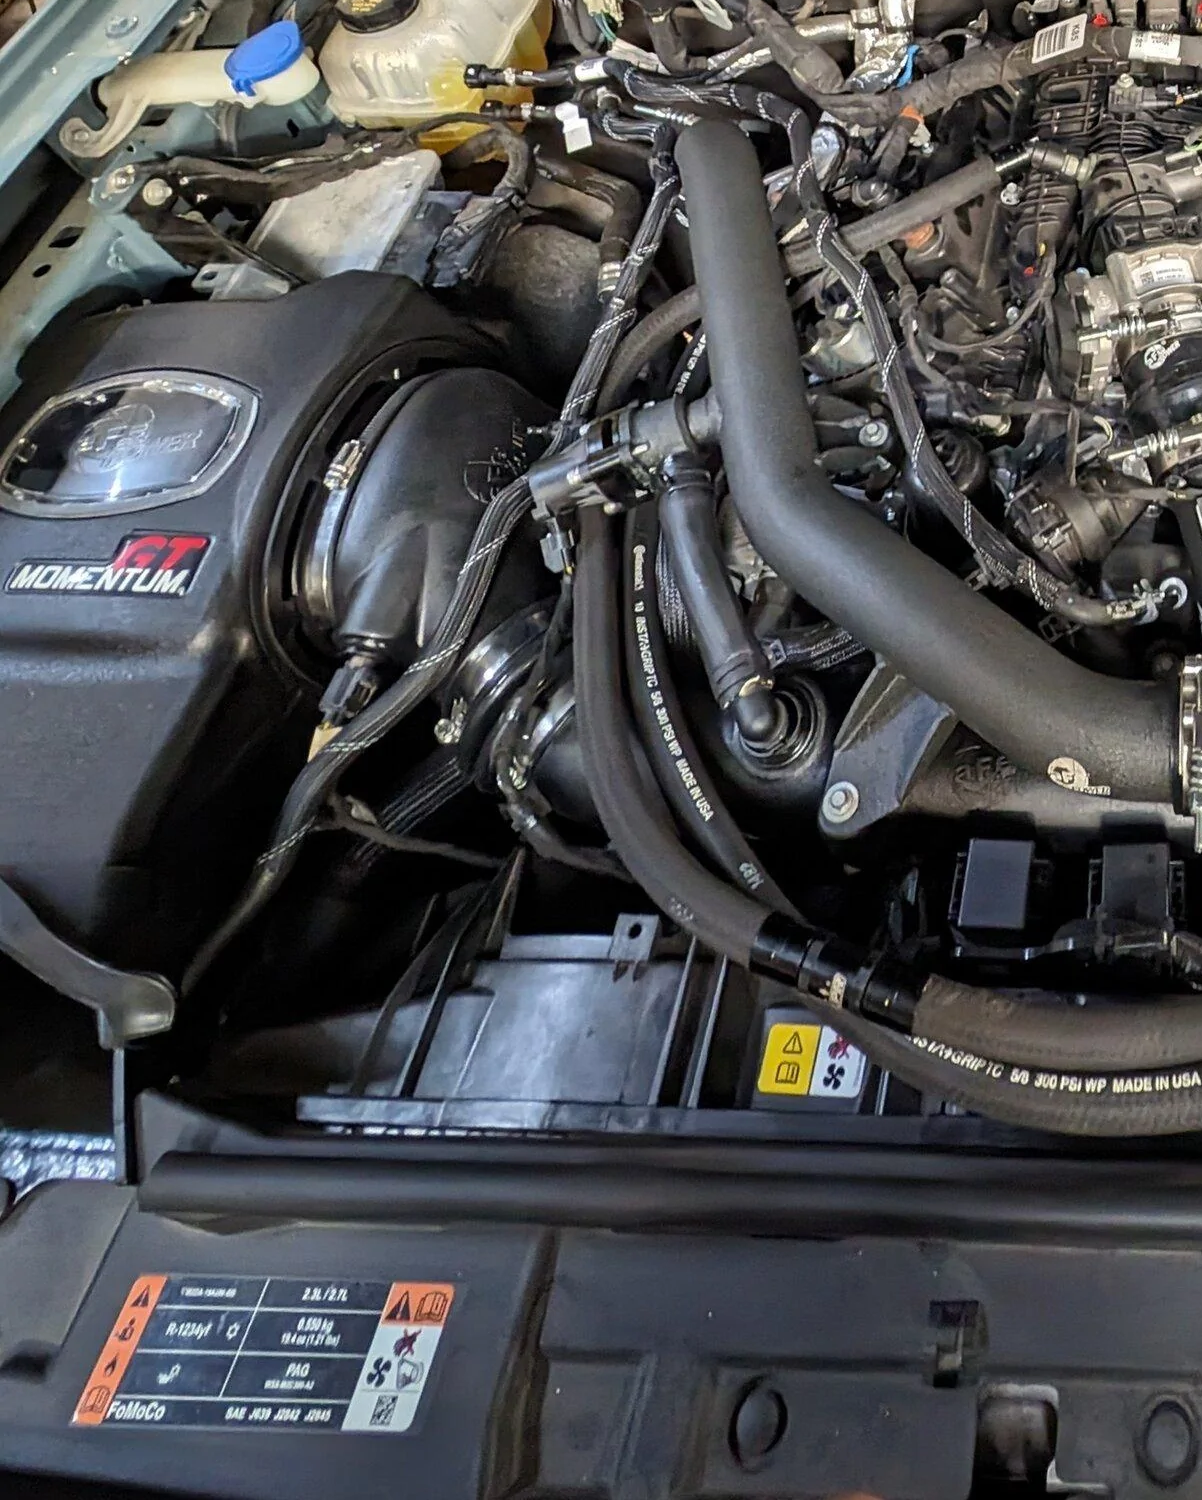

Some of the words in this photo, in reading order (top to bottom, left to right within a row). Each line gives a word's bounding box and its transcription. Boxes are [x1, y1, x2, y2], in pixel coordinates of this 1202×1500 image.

[113, 536, 208, 573] GT
[10, 564, 190, 594] MOMENTUM
[662, 723, 675, 742] PSI
[668, 739, 683, 757] WP
[676, 758, 697, 789] MADE
[690, 785, 703, 800] IN
[696, 796, 714, 822] USA
[986, 1062, 1004, 1078] TC
[1010, 1068, 1029, 1085] 5/8
[1034, 1073, 1058, 1089] 300
[1060, 1076, 1081, 1092] PSI
[1085, 1078, 1107, 1093] WP
[1112, 1077, 1153, 1093] MADE
[1155, 1076, 1169, 1091] IN
[1172, 1071, 1201, 1088] USA
[106, 1400, 166, 1421] FoMoCo
[225, 1406, 247, 1421] SAE
[249, 1407, 272, 1421] J639
